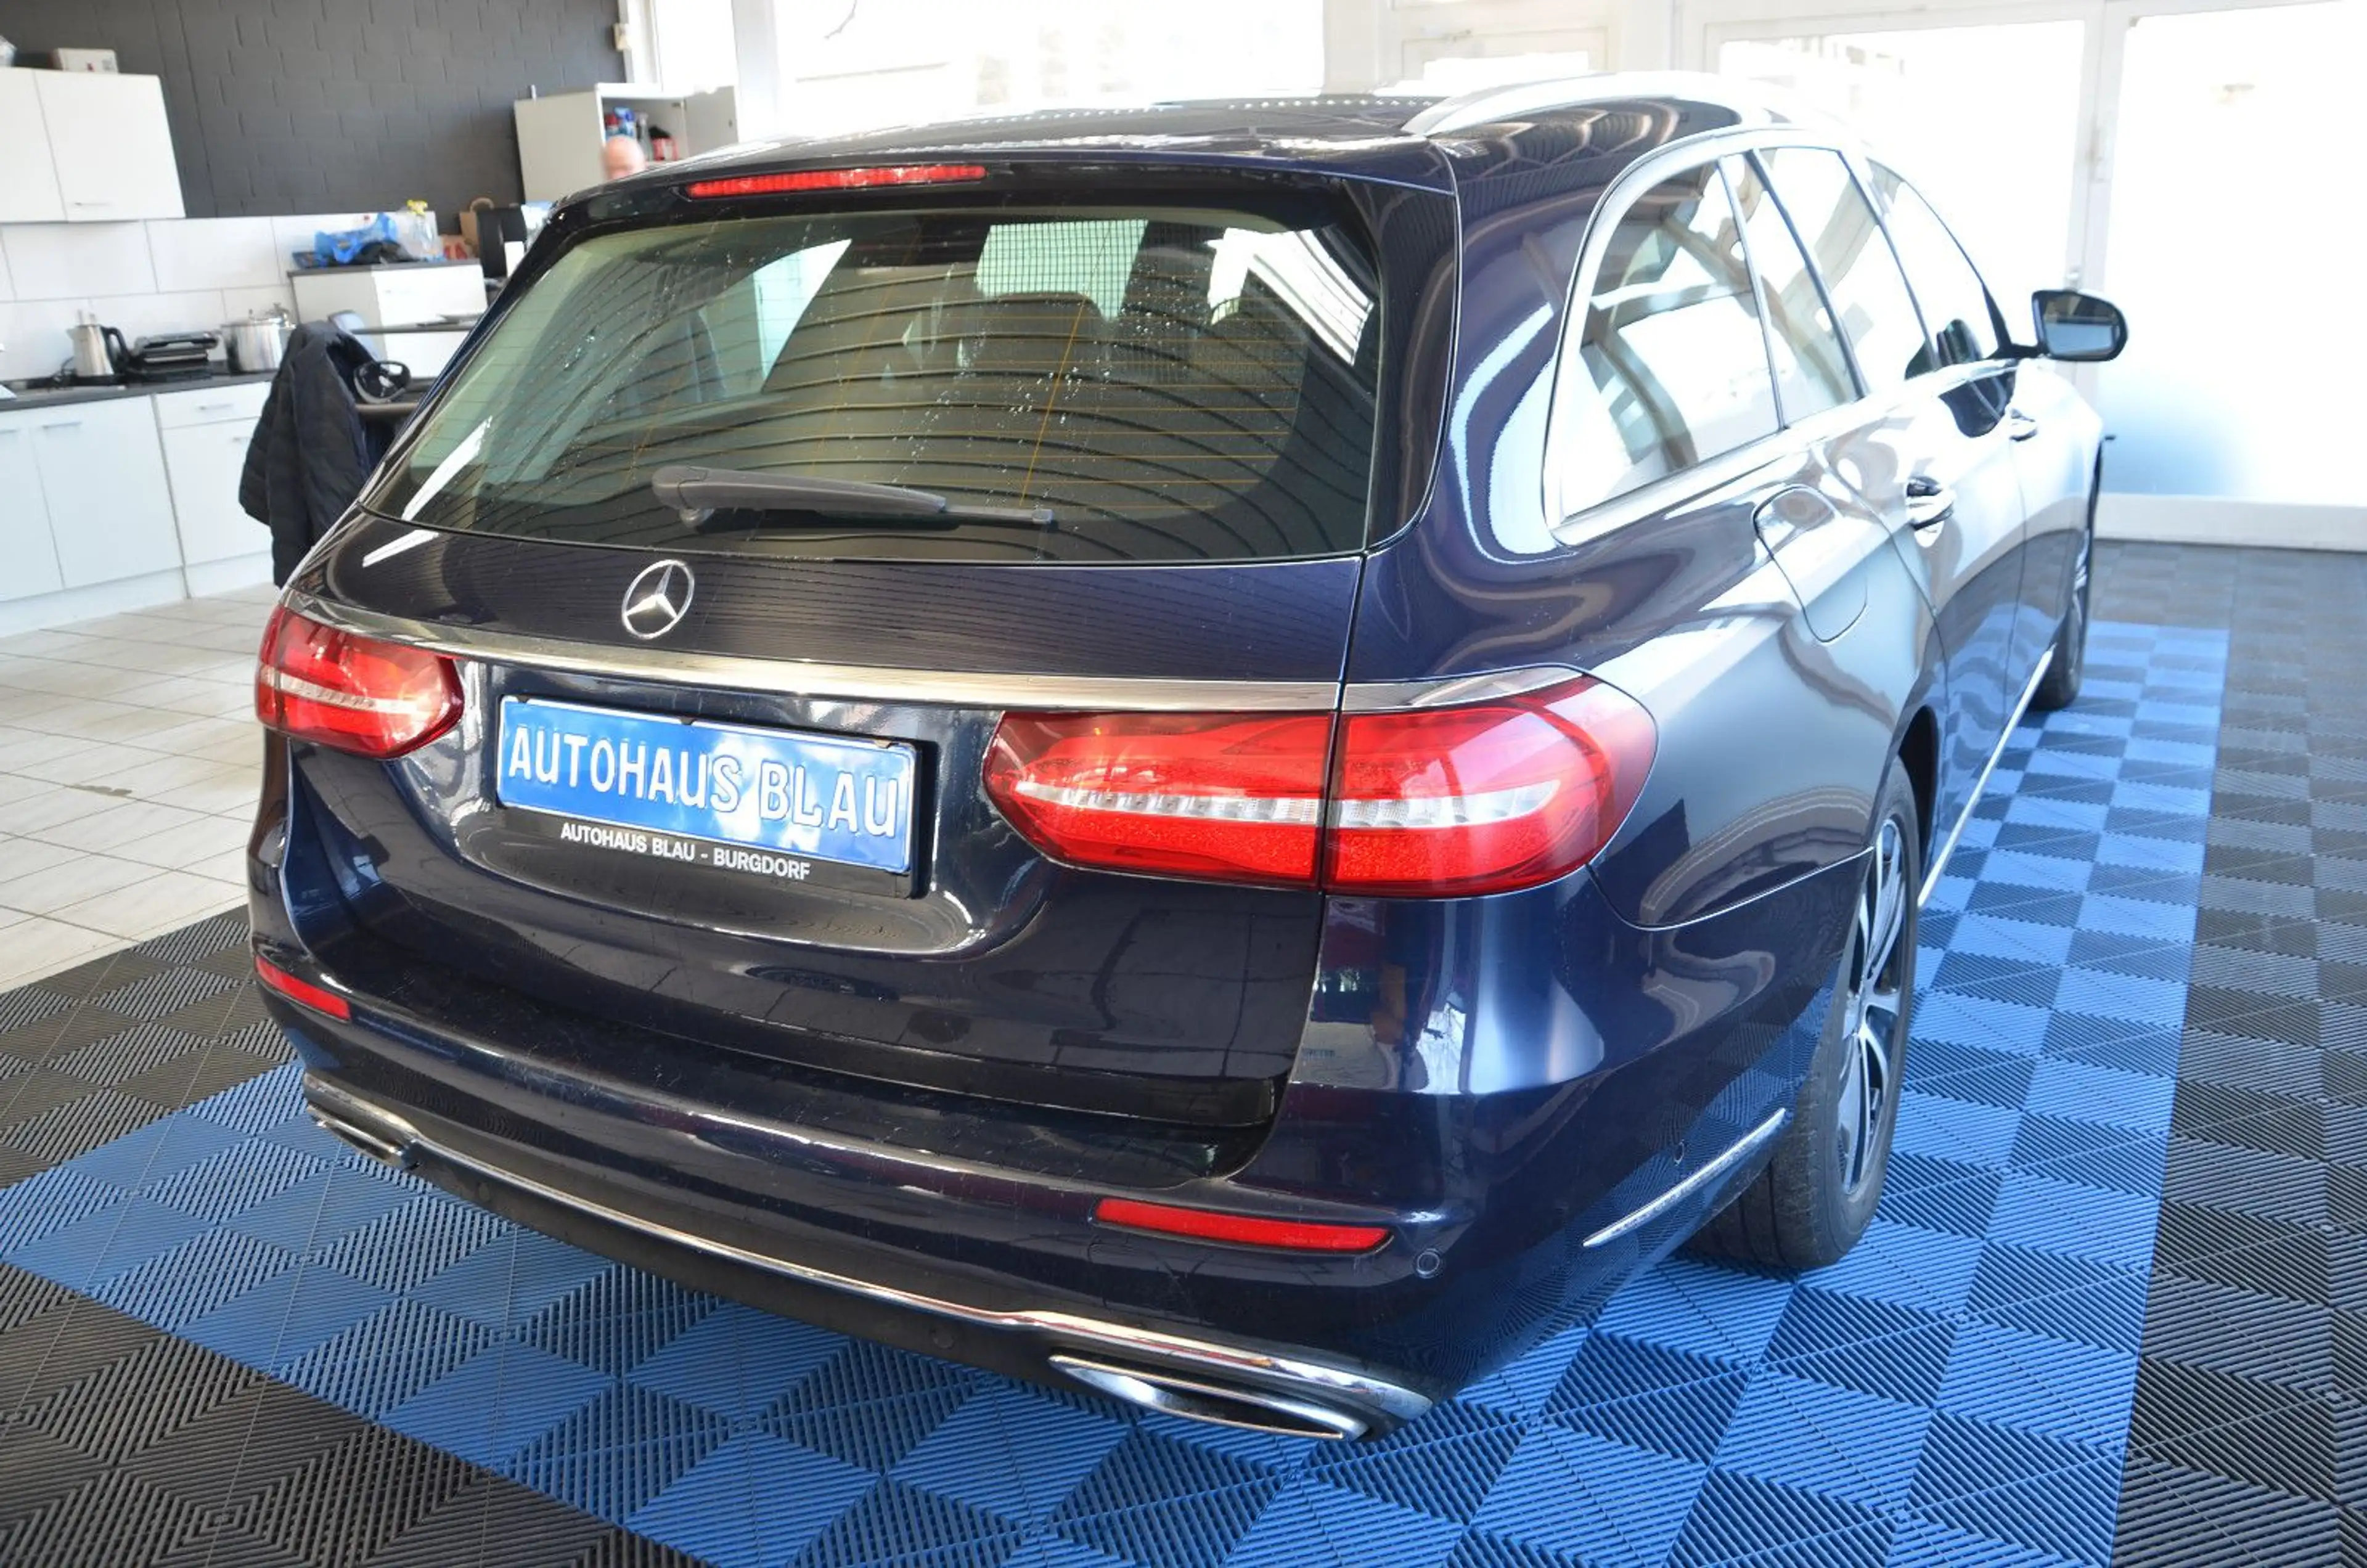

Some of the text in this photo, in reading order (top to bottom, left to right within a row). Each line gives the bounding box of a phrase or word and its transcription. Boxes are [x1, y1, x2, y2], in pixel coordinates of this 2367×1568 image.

[509, 724, 897, 838] AUTOHAUS BLAU
[561, 822, 648, 853] AUTOHAUS
[652, 838, 695, 861] BLAU
[714, 848, 811, 880] BURGDORF
